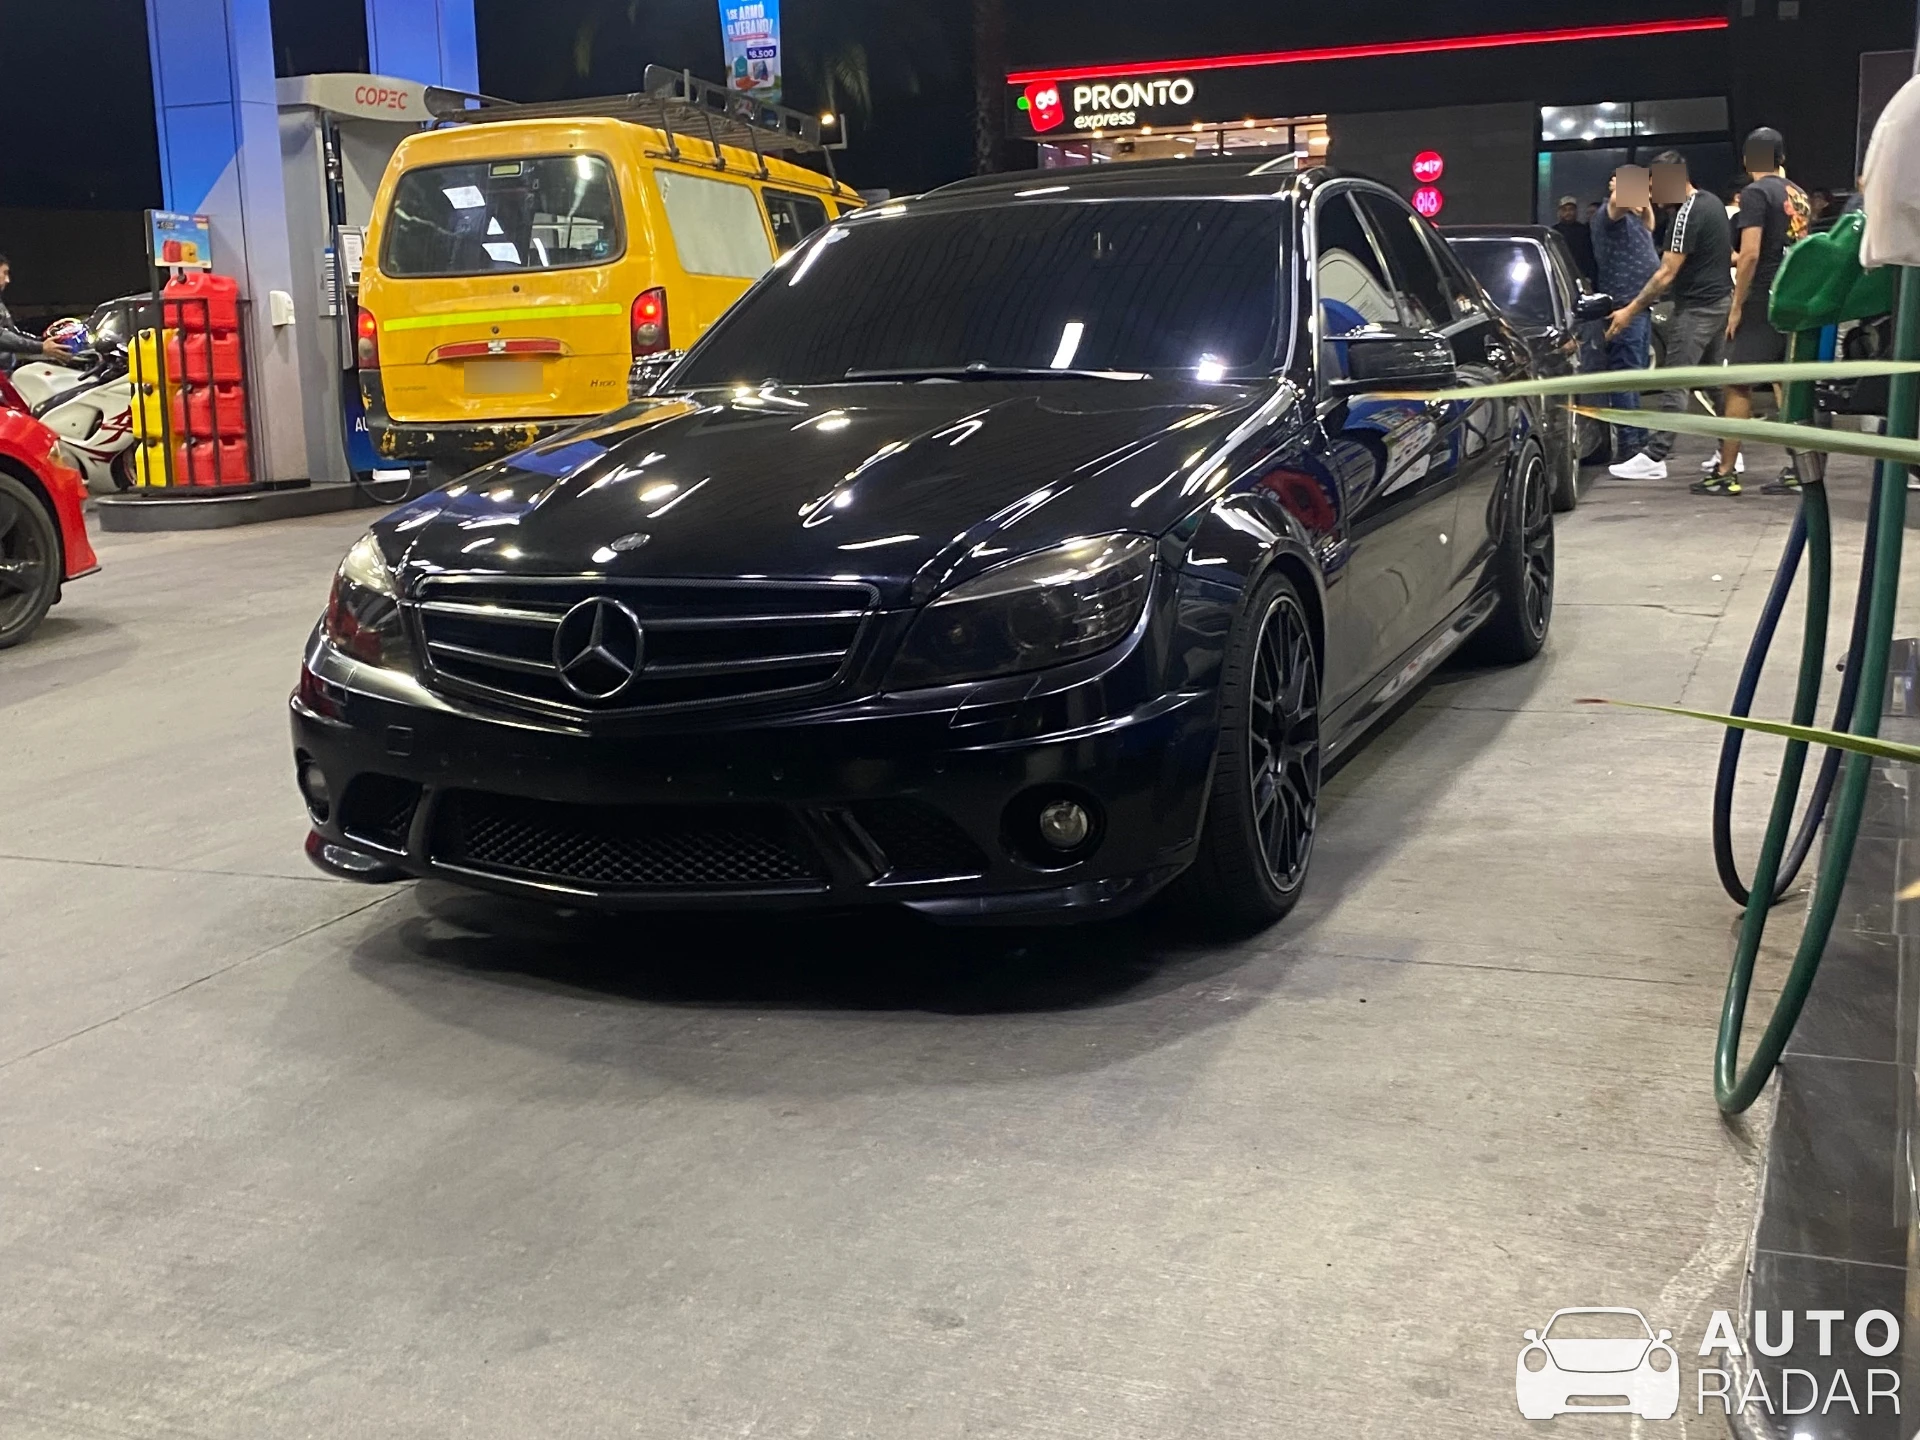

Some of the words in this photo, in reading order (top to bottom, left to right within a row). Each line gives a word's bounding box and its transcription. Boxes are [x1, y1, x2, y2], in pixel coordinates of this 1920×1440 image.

[735, 19, 774, 35] VERANO!
[355, 86, 408, 110] COPEC
[1074, 79, 1194, 112] PRONTO
[1074, 112, 1136, 130] express
